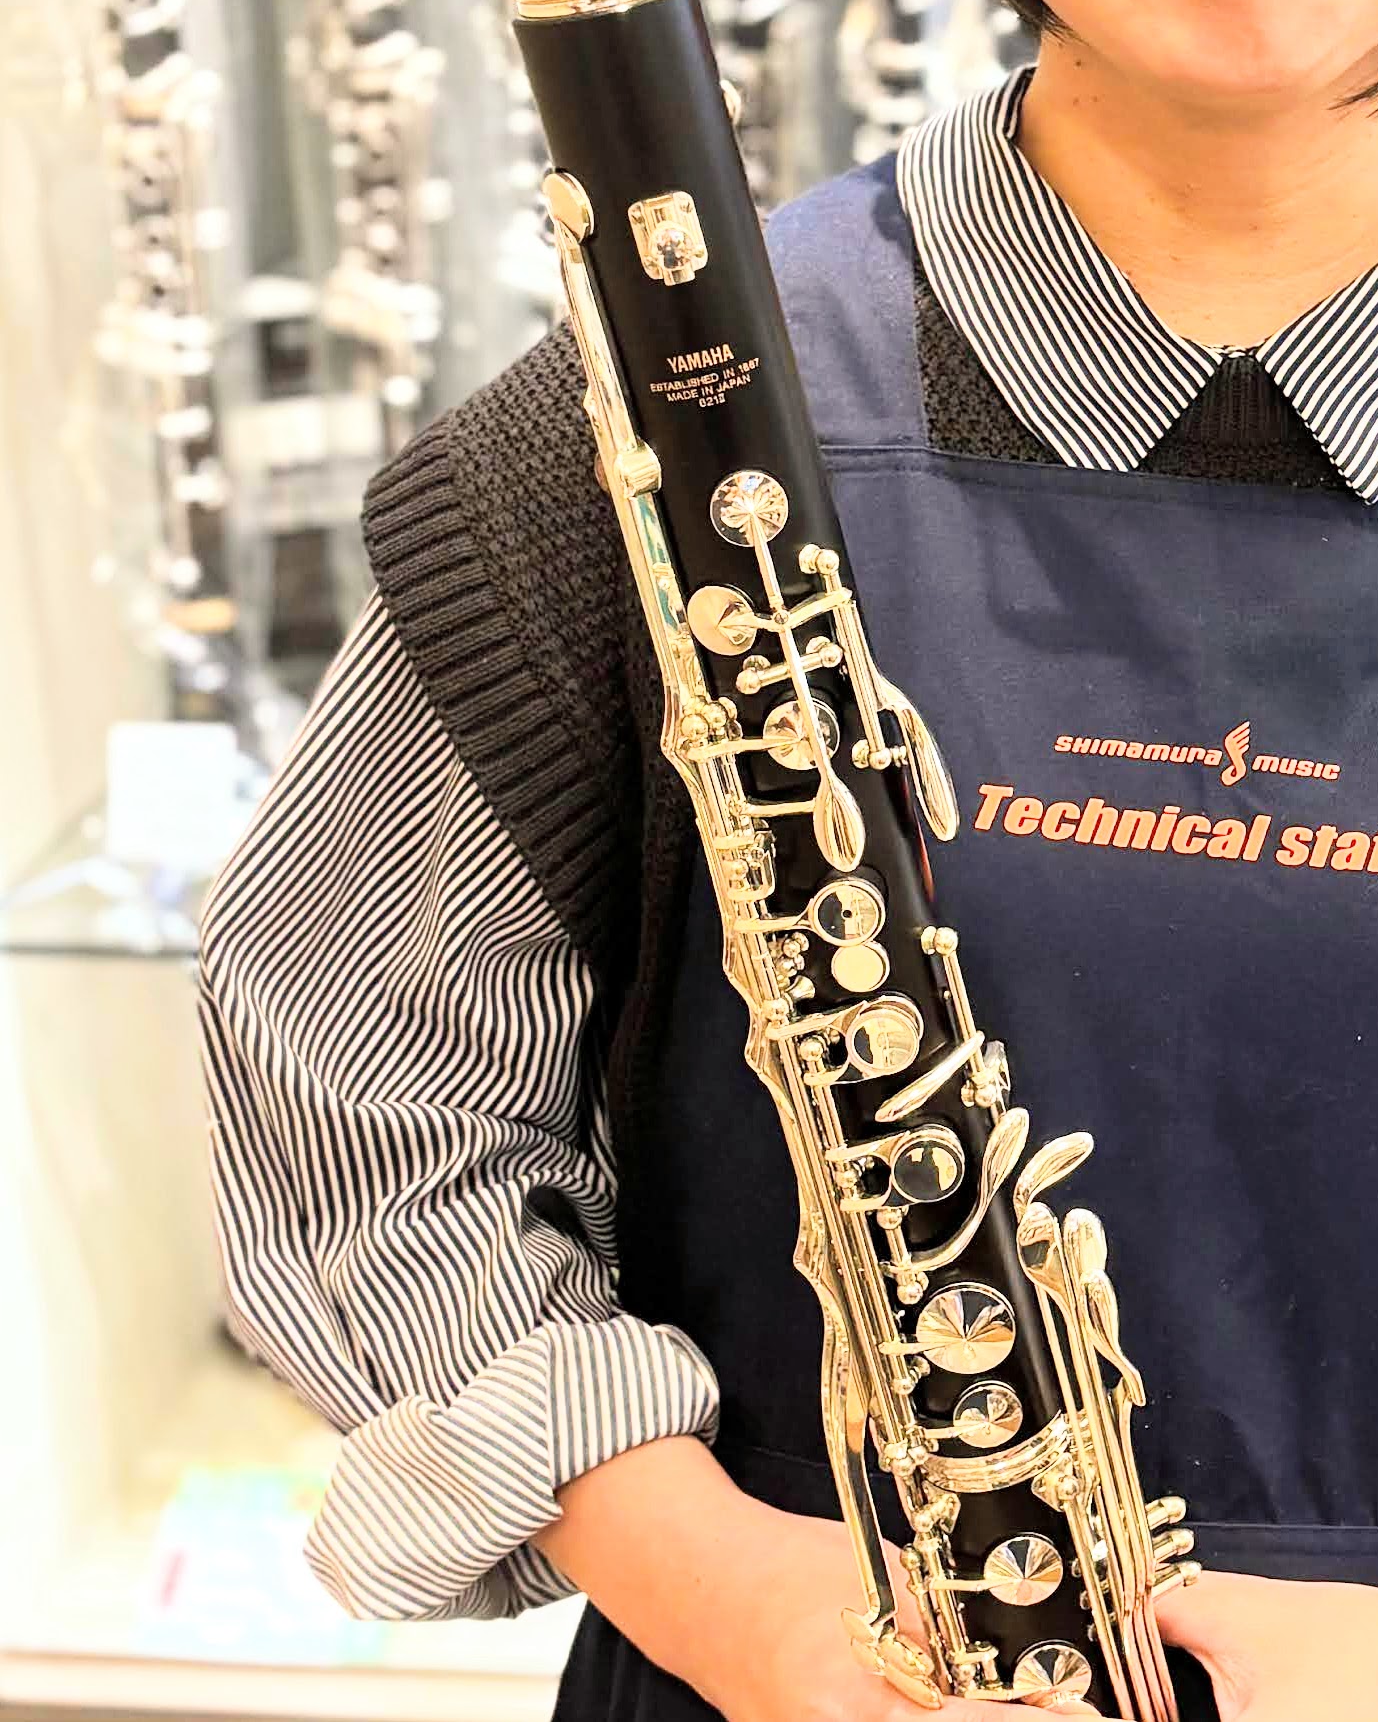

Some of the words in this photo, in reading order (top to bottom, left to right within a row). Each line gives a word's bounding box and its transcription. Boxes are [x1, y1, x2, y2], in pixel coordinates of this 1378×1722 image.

[667, 344, 734, 374] YAMAHA
[650, 373, 719, 392] ESTABLISHED
[723, 367, 735, 379] IN
[667, 389, 699, 402] MADE
[701, 386, 713, 396] IN
[717, 374, 751, 392] JAPAN
[974, 783, 1271, 862] Technical
